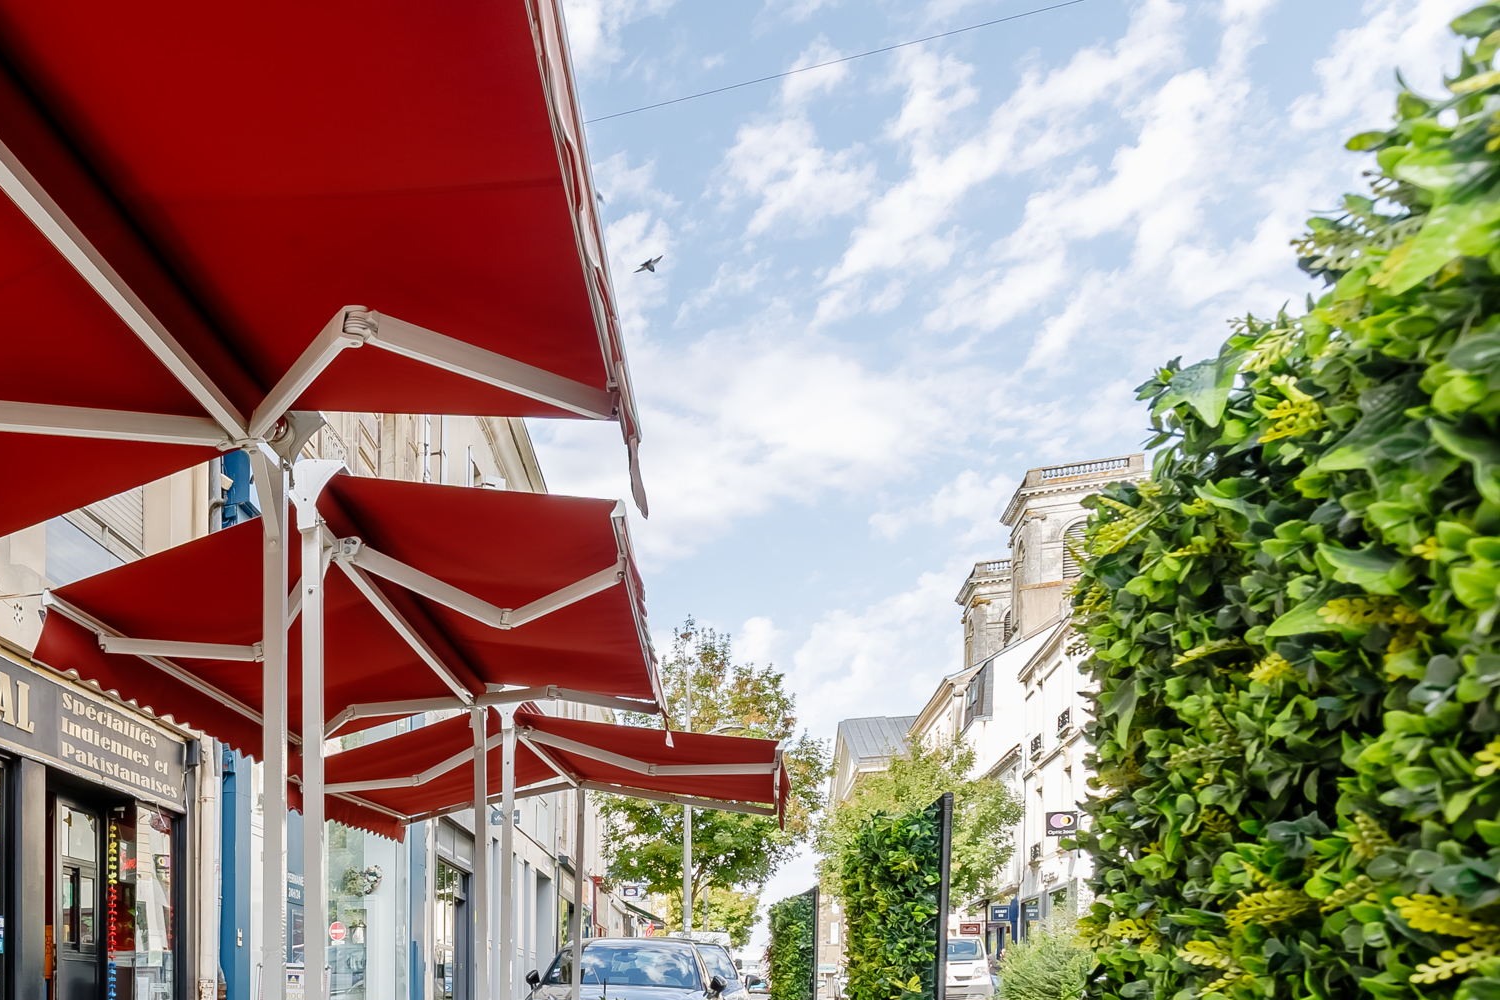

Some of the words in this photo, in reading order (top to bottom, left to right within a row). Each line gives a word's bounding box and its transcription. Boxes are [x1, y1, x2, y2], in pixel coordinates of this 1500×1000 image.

[61, 716, 149, 767] Indiennes
[154, 760, 169, 776] et
[62, 692, 157, 749] Spécialités
[61, 741, 178, 799] Pakistanaises
[287, 872, 304, 887] PERMANE
